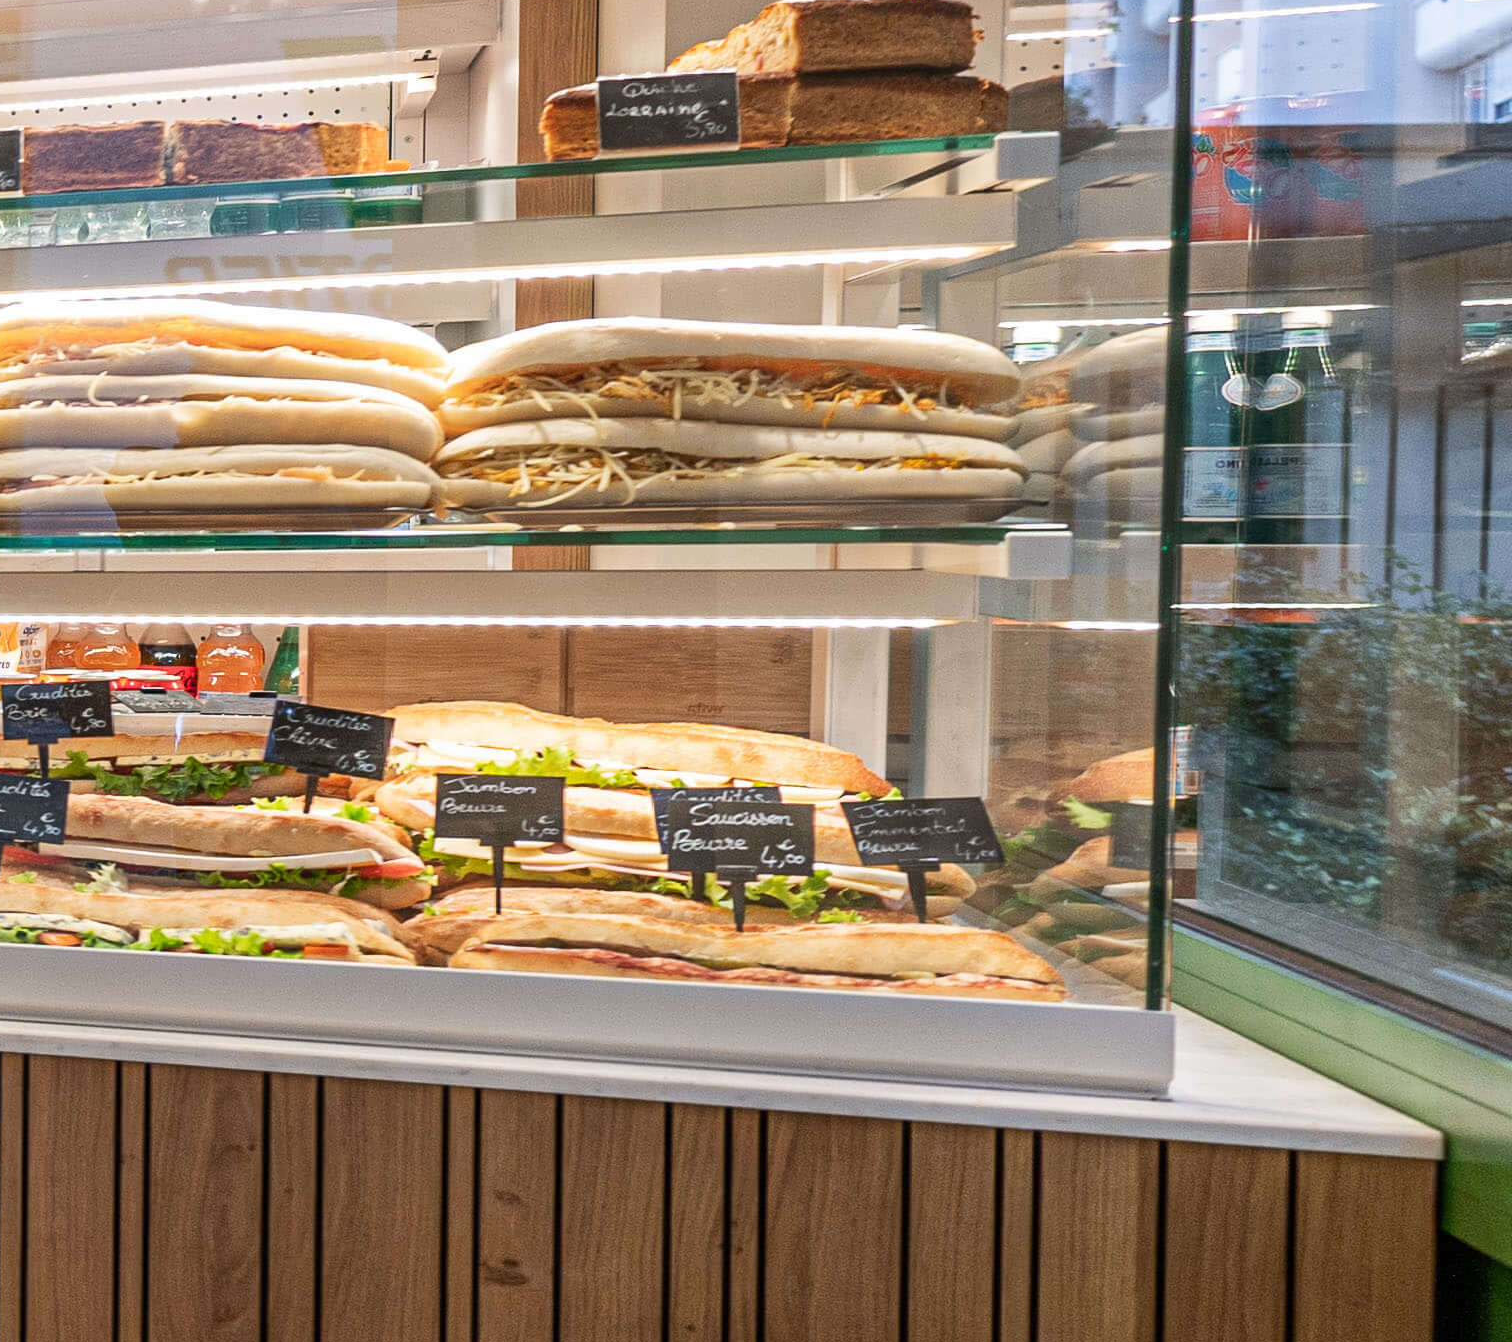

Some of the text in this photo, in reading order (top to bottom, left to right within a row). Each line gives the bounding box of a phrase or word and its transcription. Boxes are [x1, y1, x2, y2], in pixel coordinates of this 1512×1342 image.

[622, 82, 700, 98] Quiche
[15, 683, 93, 701] Crudités
[5, 704, 48, 720] Brie
[285, 706, 371, 731] Crudités
[274, 726, 337, 749] Chèvre
[444, 776, 537, 795] Jambon
[441, 798, 506, 813] Beurre
[856, 804, 945, 819] Jambon
[689, 804, 794, 826] Saucisson
[854, 819, 965, 837] Emmental
[672, 830, 749, 851] Beurre
[859, 841, 920, 854] Beurre
